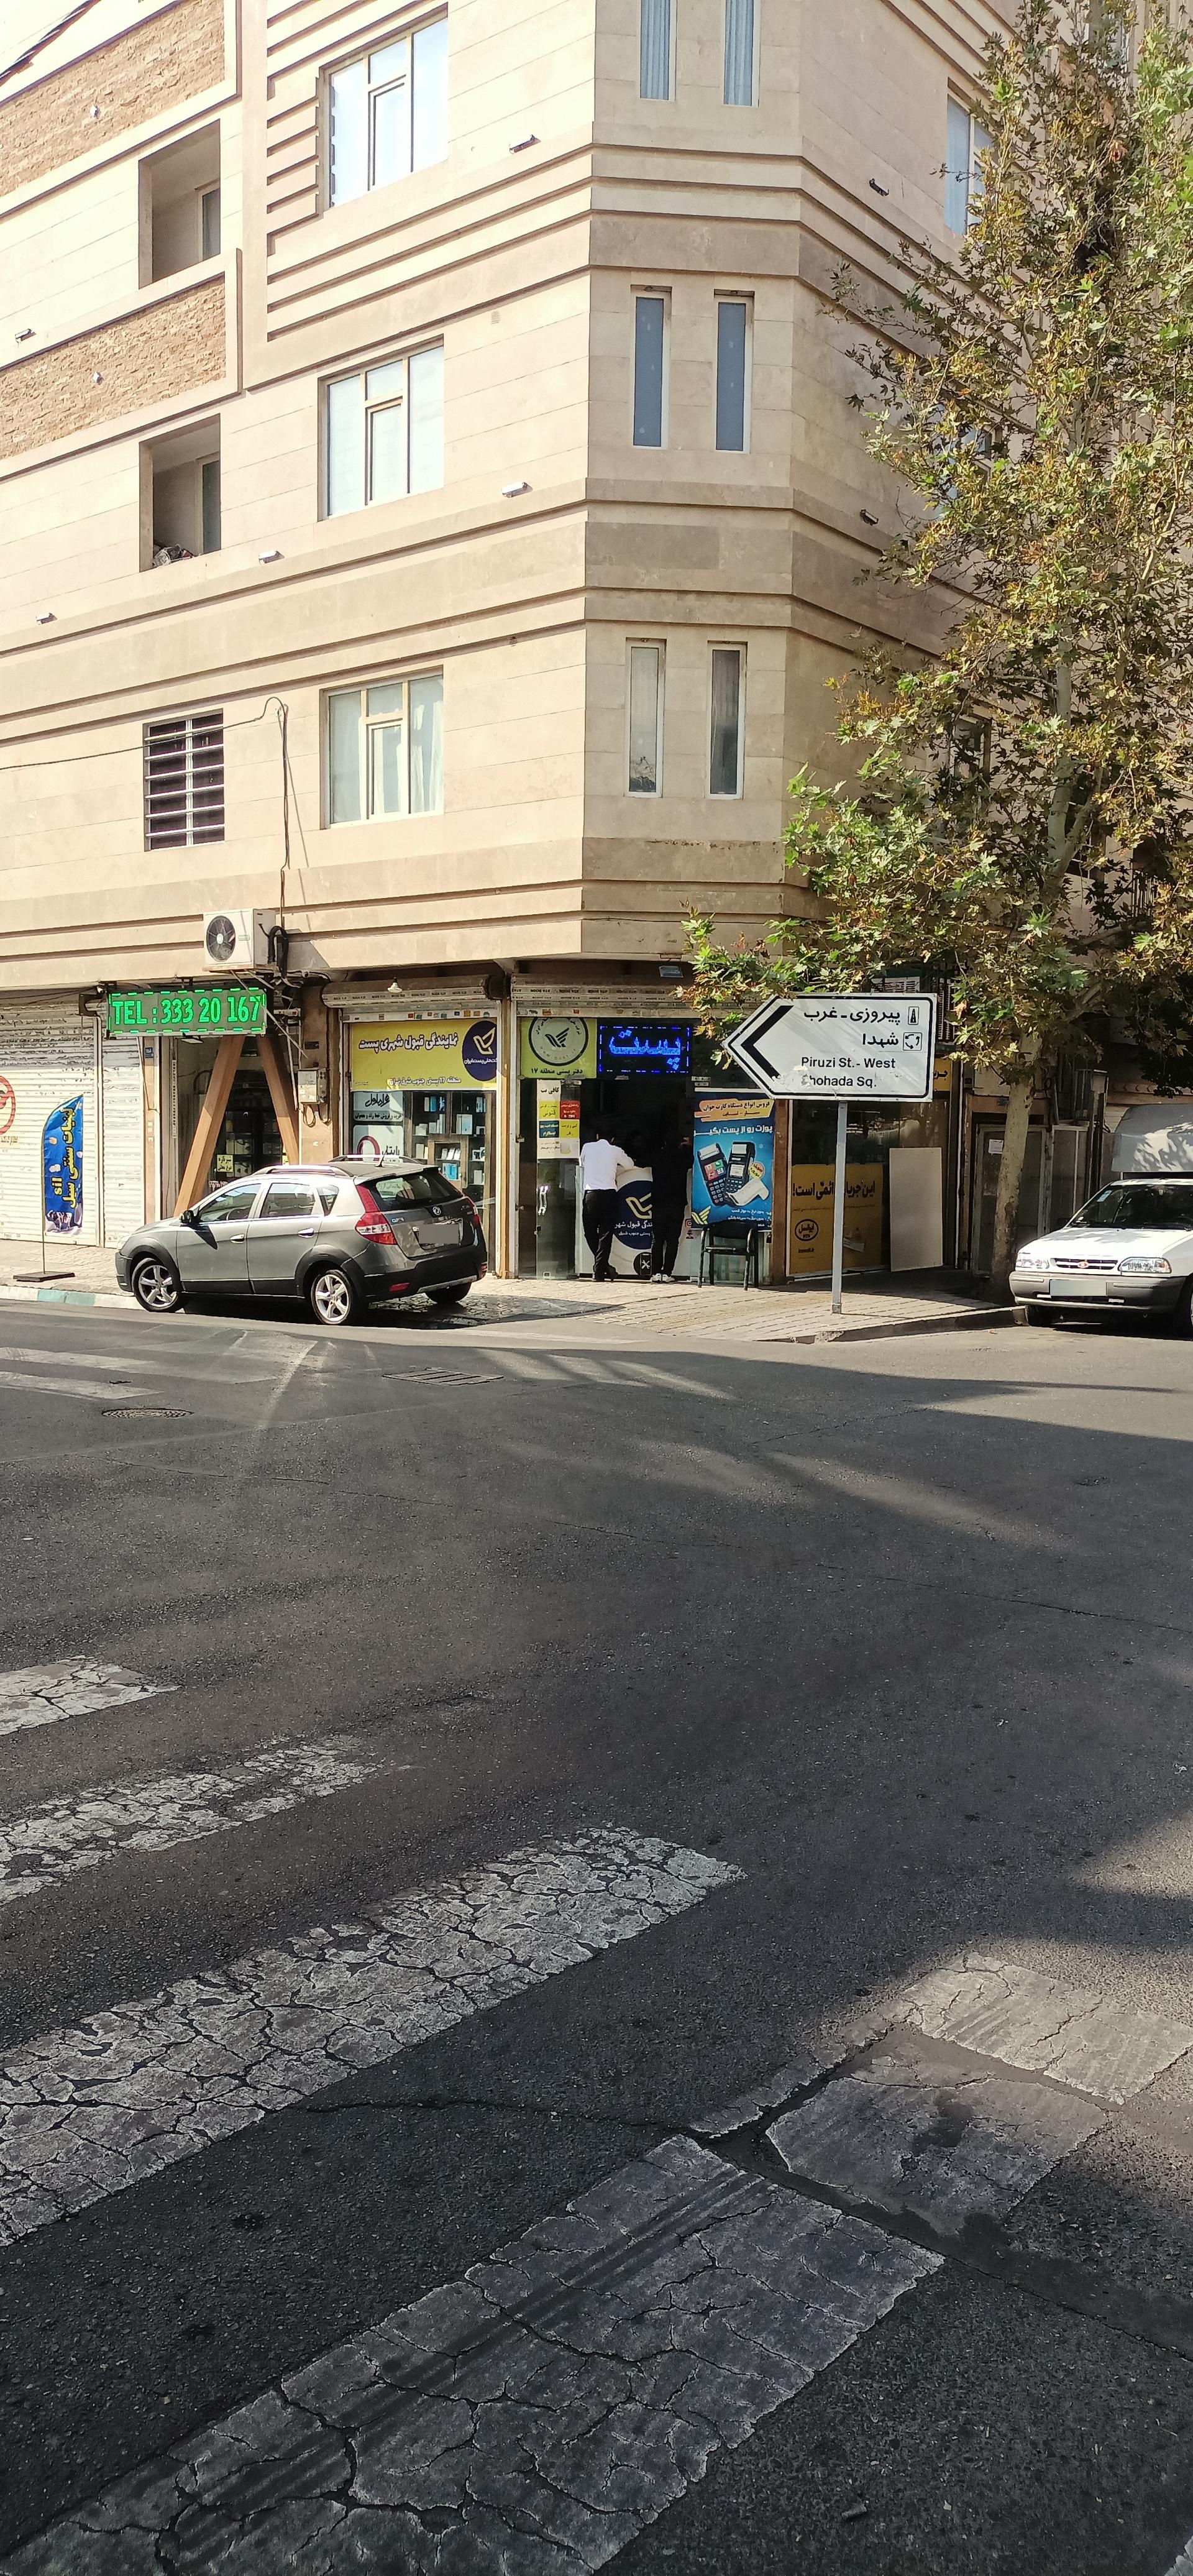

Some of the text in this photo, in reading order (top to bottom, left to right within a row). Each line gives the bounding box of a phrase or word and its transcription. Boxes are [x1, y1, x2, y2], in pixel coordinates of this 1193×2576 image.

[111, 1000, 147, 1025] TEL
[160, 997, 194, 1024] 333
[198, 997, 221, 1024] 20
[227, 996, 261, 1022] 167
[803, 1006, 838, 1022] غرب
[849, 1008, 900, 1025] پیروزی
[359, 1032, 459, 1054] نمایندگی قبول شهری پست
[862, 1032, 899, 1048] شهدا
[608, 1029, 681, 1070] پست
[801, 1057, 836, 1068] Piruzi
[864, 1058, 896, 1068] West
[856, 1076, 877, 1088] Sq.
[744, 1101, 756, 1109] انواع
[722, 1127, 739, 1135] پست
[741, 1125, 746, 1134] از
[60, 1107, 79, 1209] لبنیات سنتی سیل
[52, 1176, 63, 1196] sil
[844, 1181, 861, 1198] جریا
[862, 1181, 875, 1198] این
[627, 1221, 641, 1229] قبول
